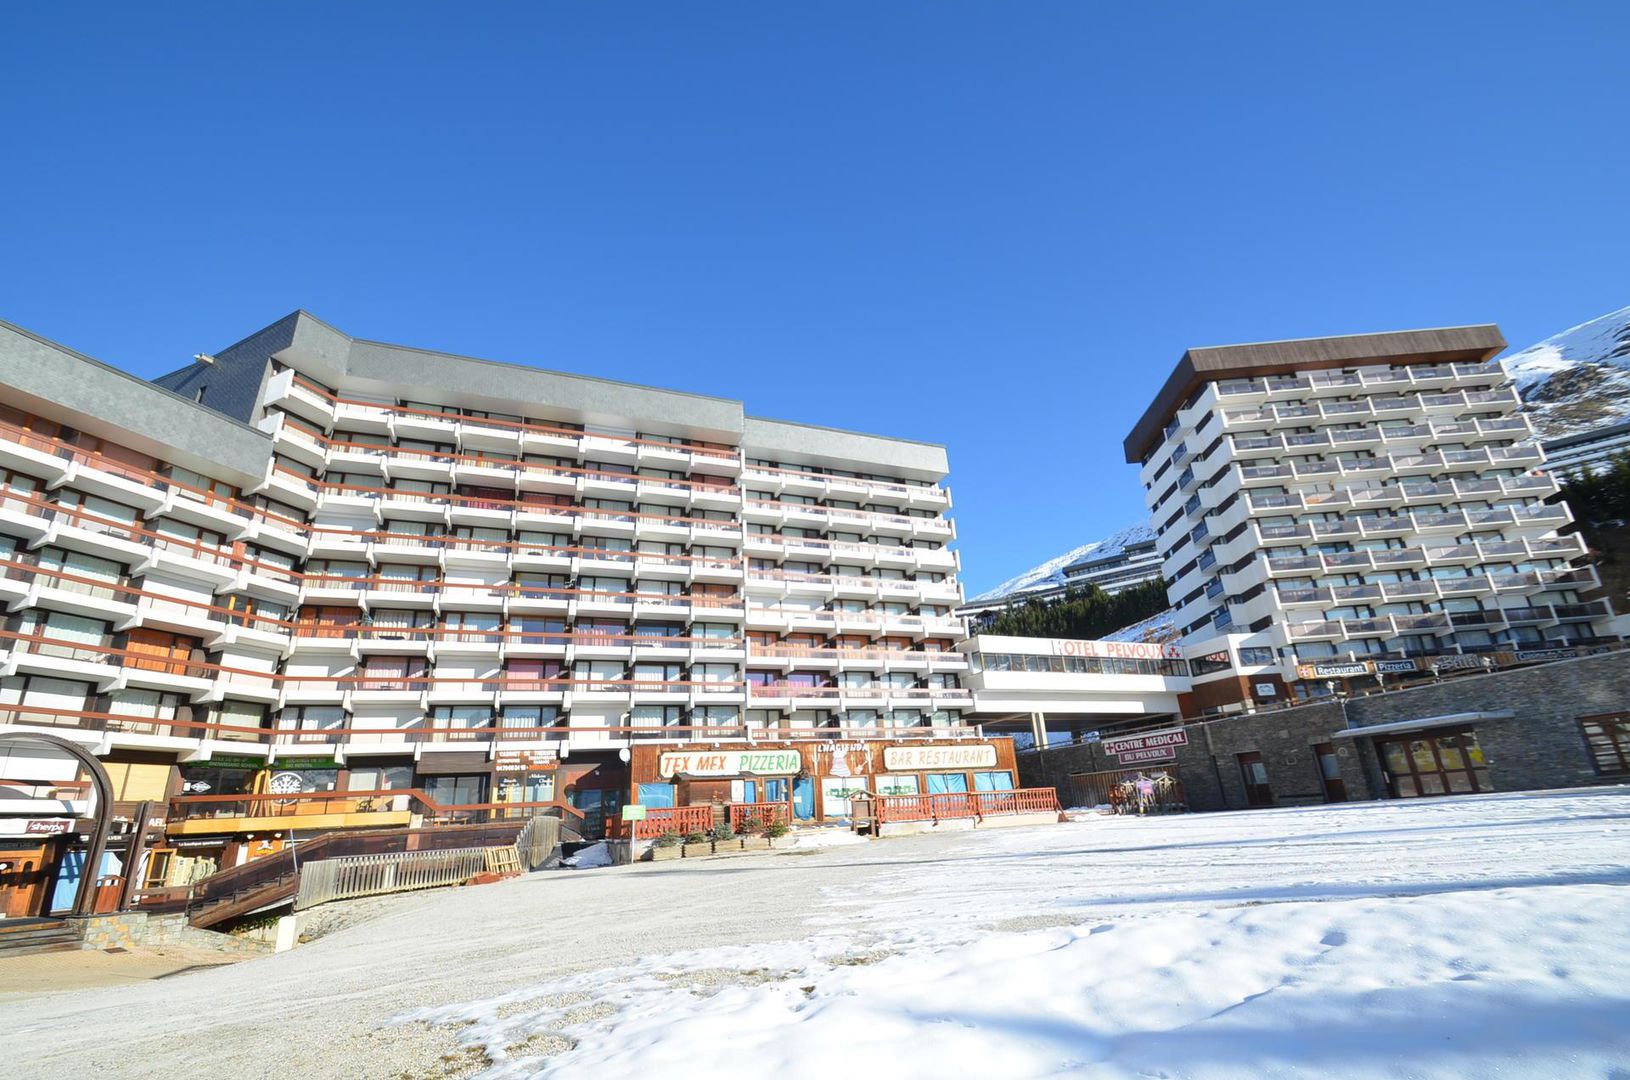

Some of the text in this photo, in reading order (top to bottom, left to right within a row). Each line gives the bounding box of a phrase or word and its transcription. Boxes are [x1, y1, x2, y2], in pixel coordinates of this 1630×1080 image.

[1106, 643, 1165, 659] PELVOUX
[1318, 664, 1363, 675] Restaurant
[1379, 661, 1411, 670] Pizzeria
[1115, 733, 1185, 751] CENTRE MEDICAL
[890, 749, 991, 765] BAR RESTAURANT
[1124, 749, 1168, 760] DU PELVOUX
[664, 754, 798, 773] TEX MEX PIZZERIA
[31, 822, 65, 832] sherpa
